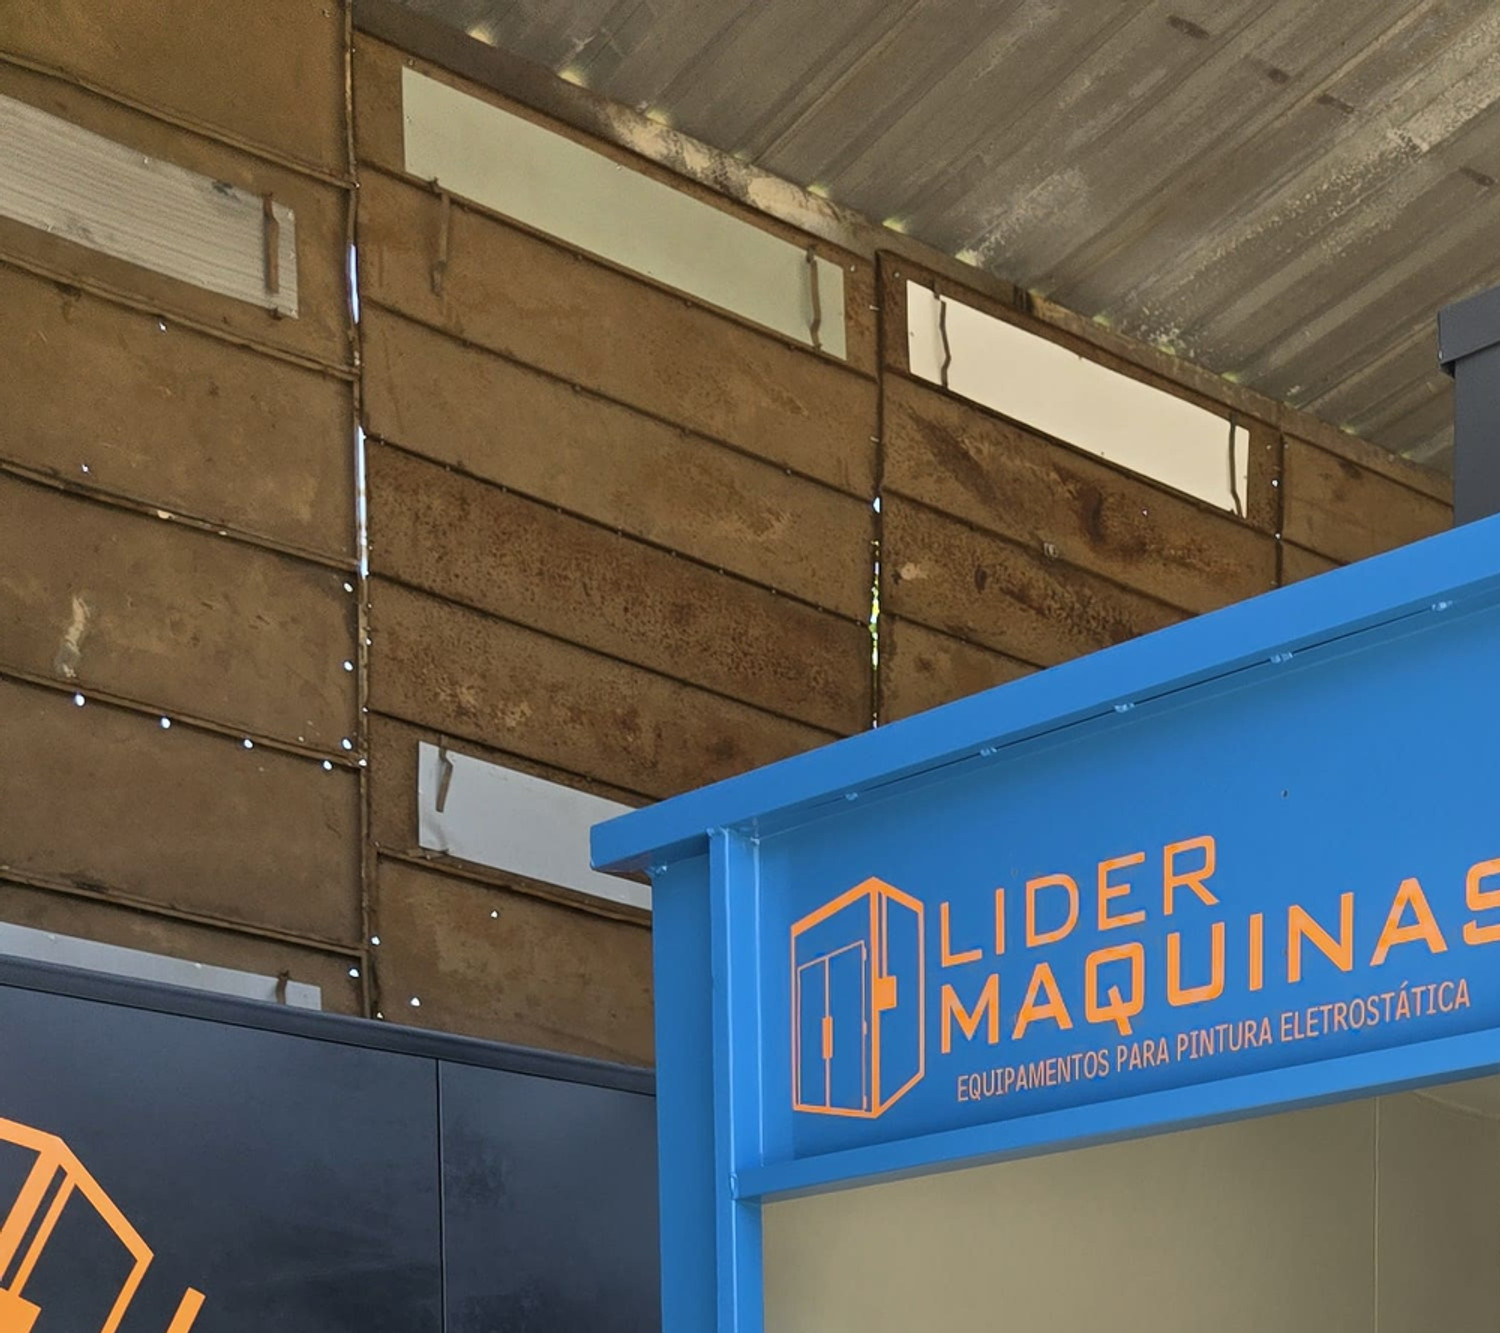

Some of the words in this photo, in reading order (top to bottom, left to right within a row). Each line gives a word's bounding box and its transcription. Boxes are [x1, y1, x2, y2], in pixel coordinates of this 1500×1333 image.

[940, 834, 1219, 968] LIDER
[957, 1048, 1110, 1102] EQUIPAMENTOS
[1116, 1038, 1170, 1073] PARA
[1176, 1017, 1273, 1060] PINTURA
[1280, 978, 1471, 1043] ELETROSTÁTICA
